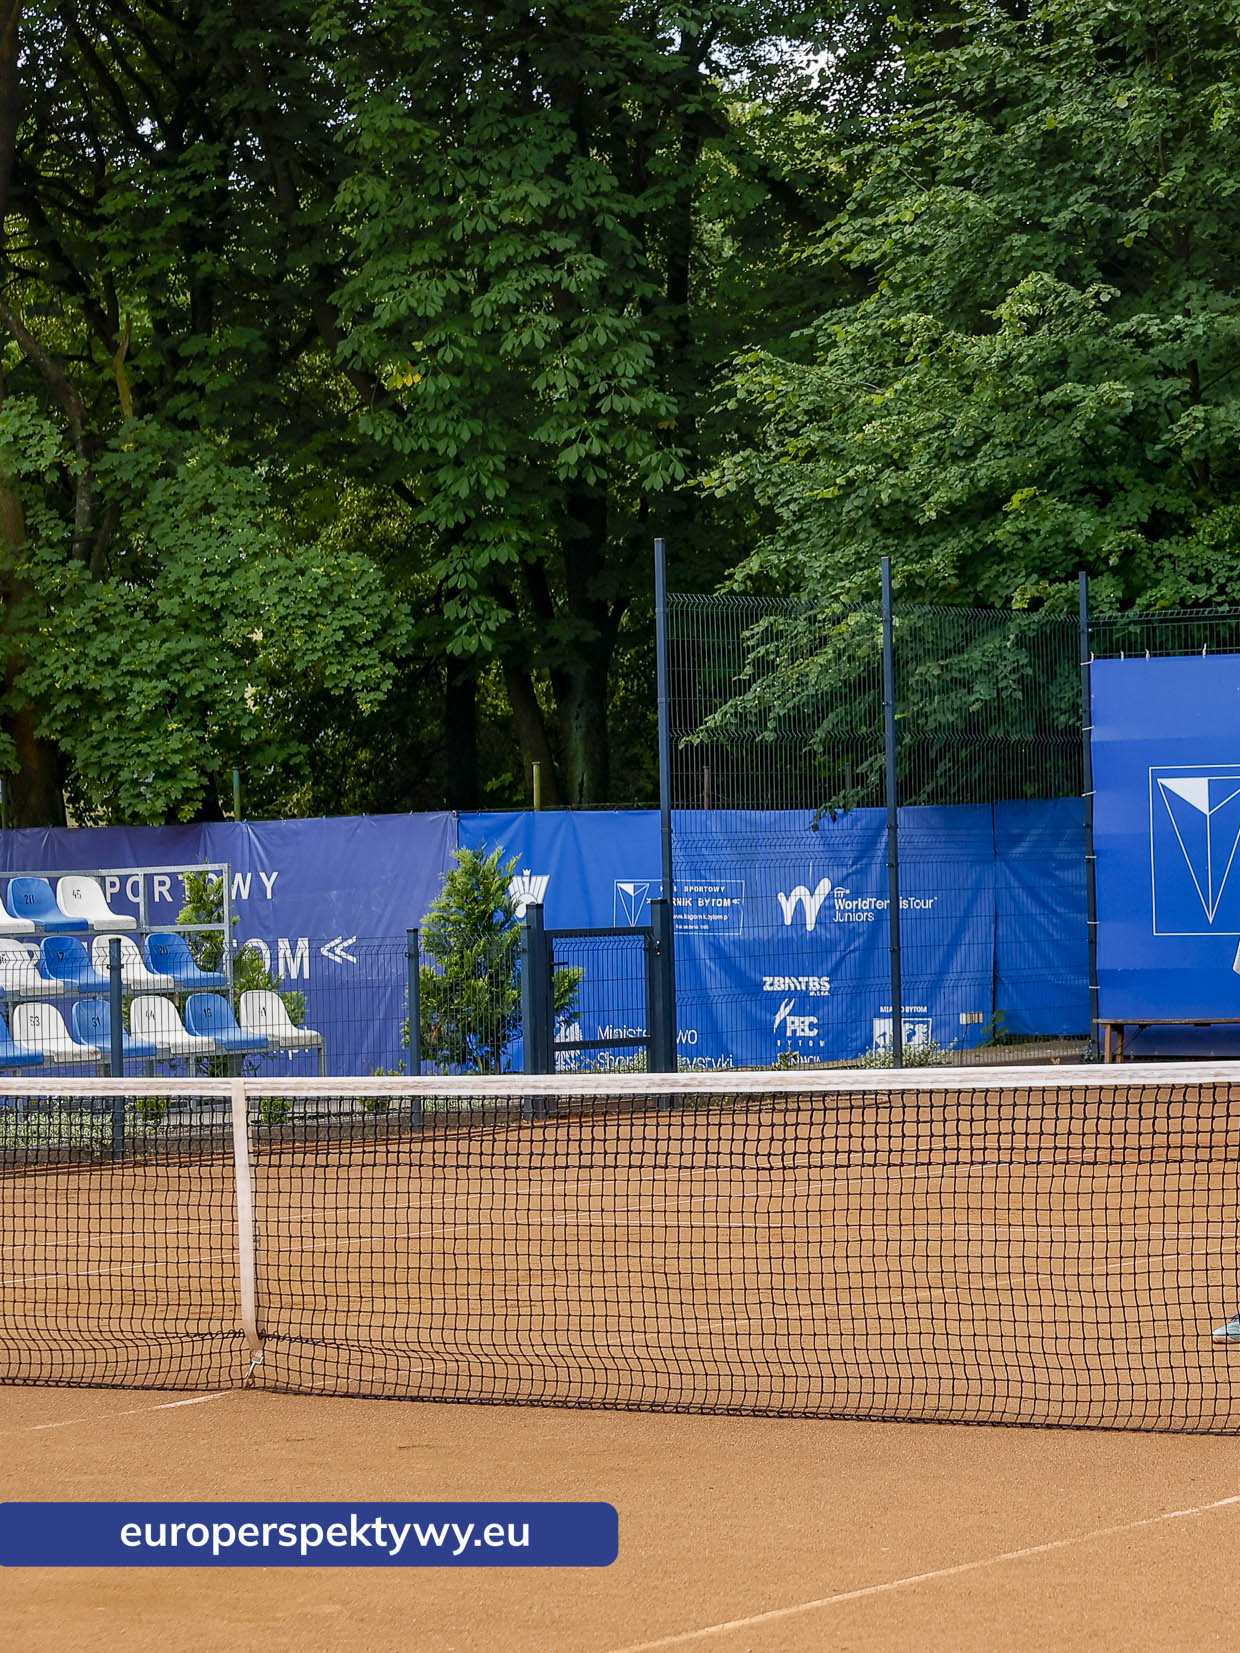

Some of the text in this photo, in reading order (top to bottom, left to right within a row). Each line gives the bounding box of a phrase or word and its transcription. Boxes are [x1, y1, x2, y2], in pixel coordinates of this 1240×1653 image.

[698, 897, 731, 907] BYTOM
[832, 911, 875, 922] Juniors
[597, 1024, 698, 1044] Ministwo
